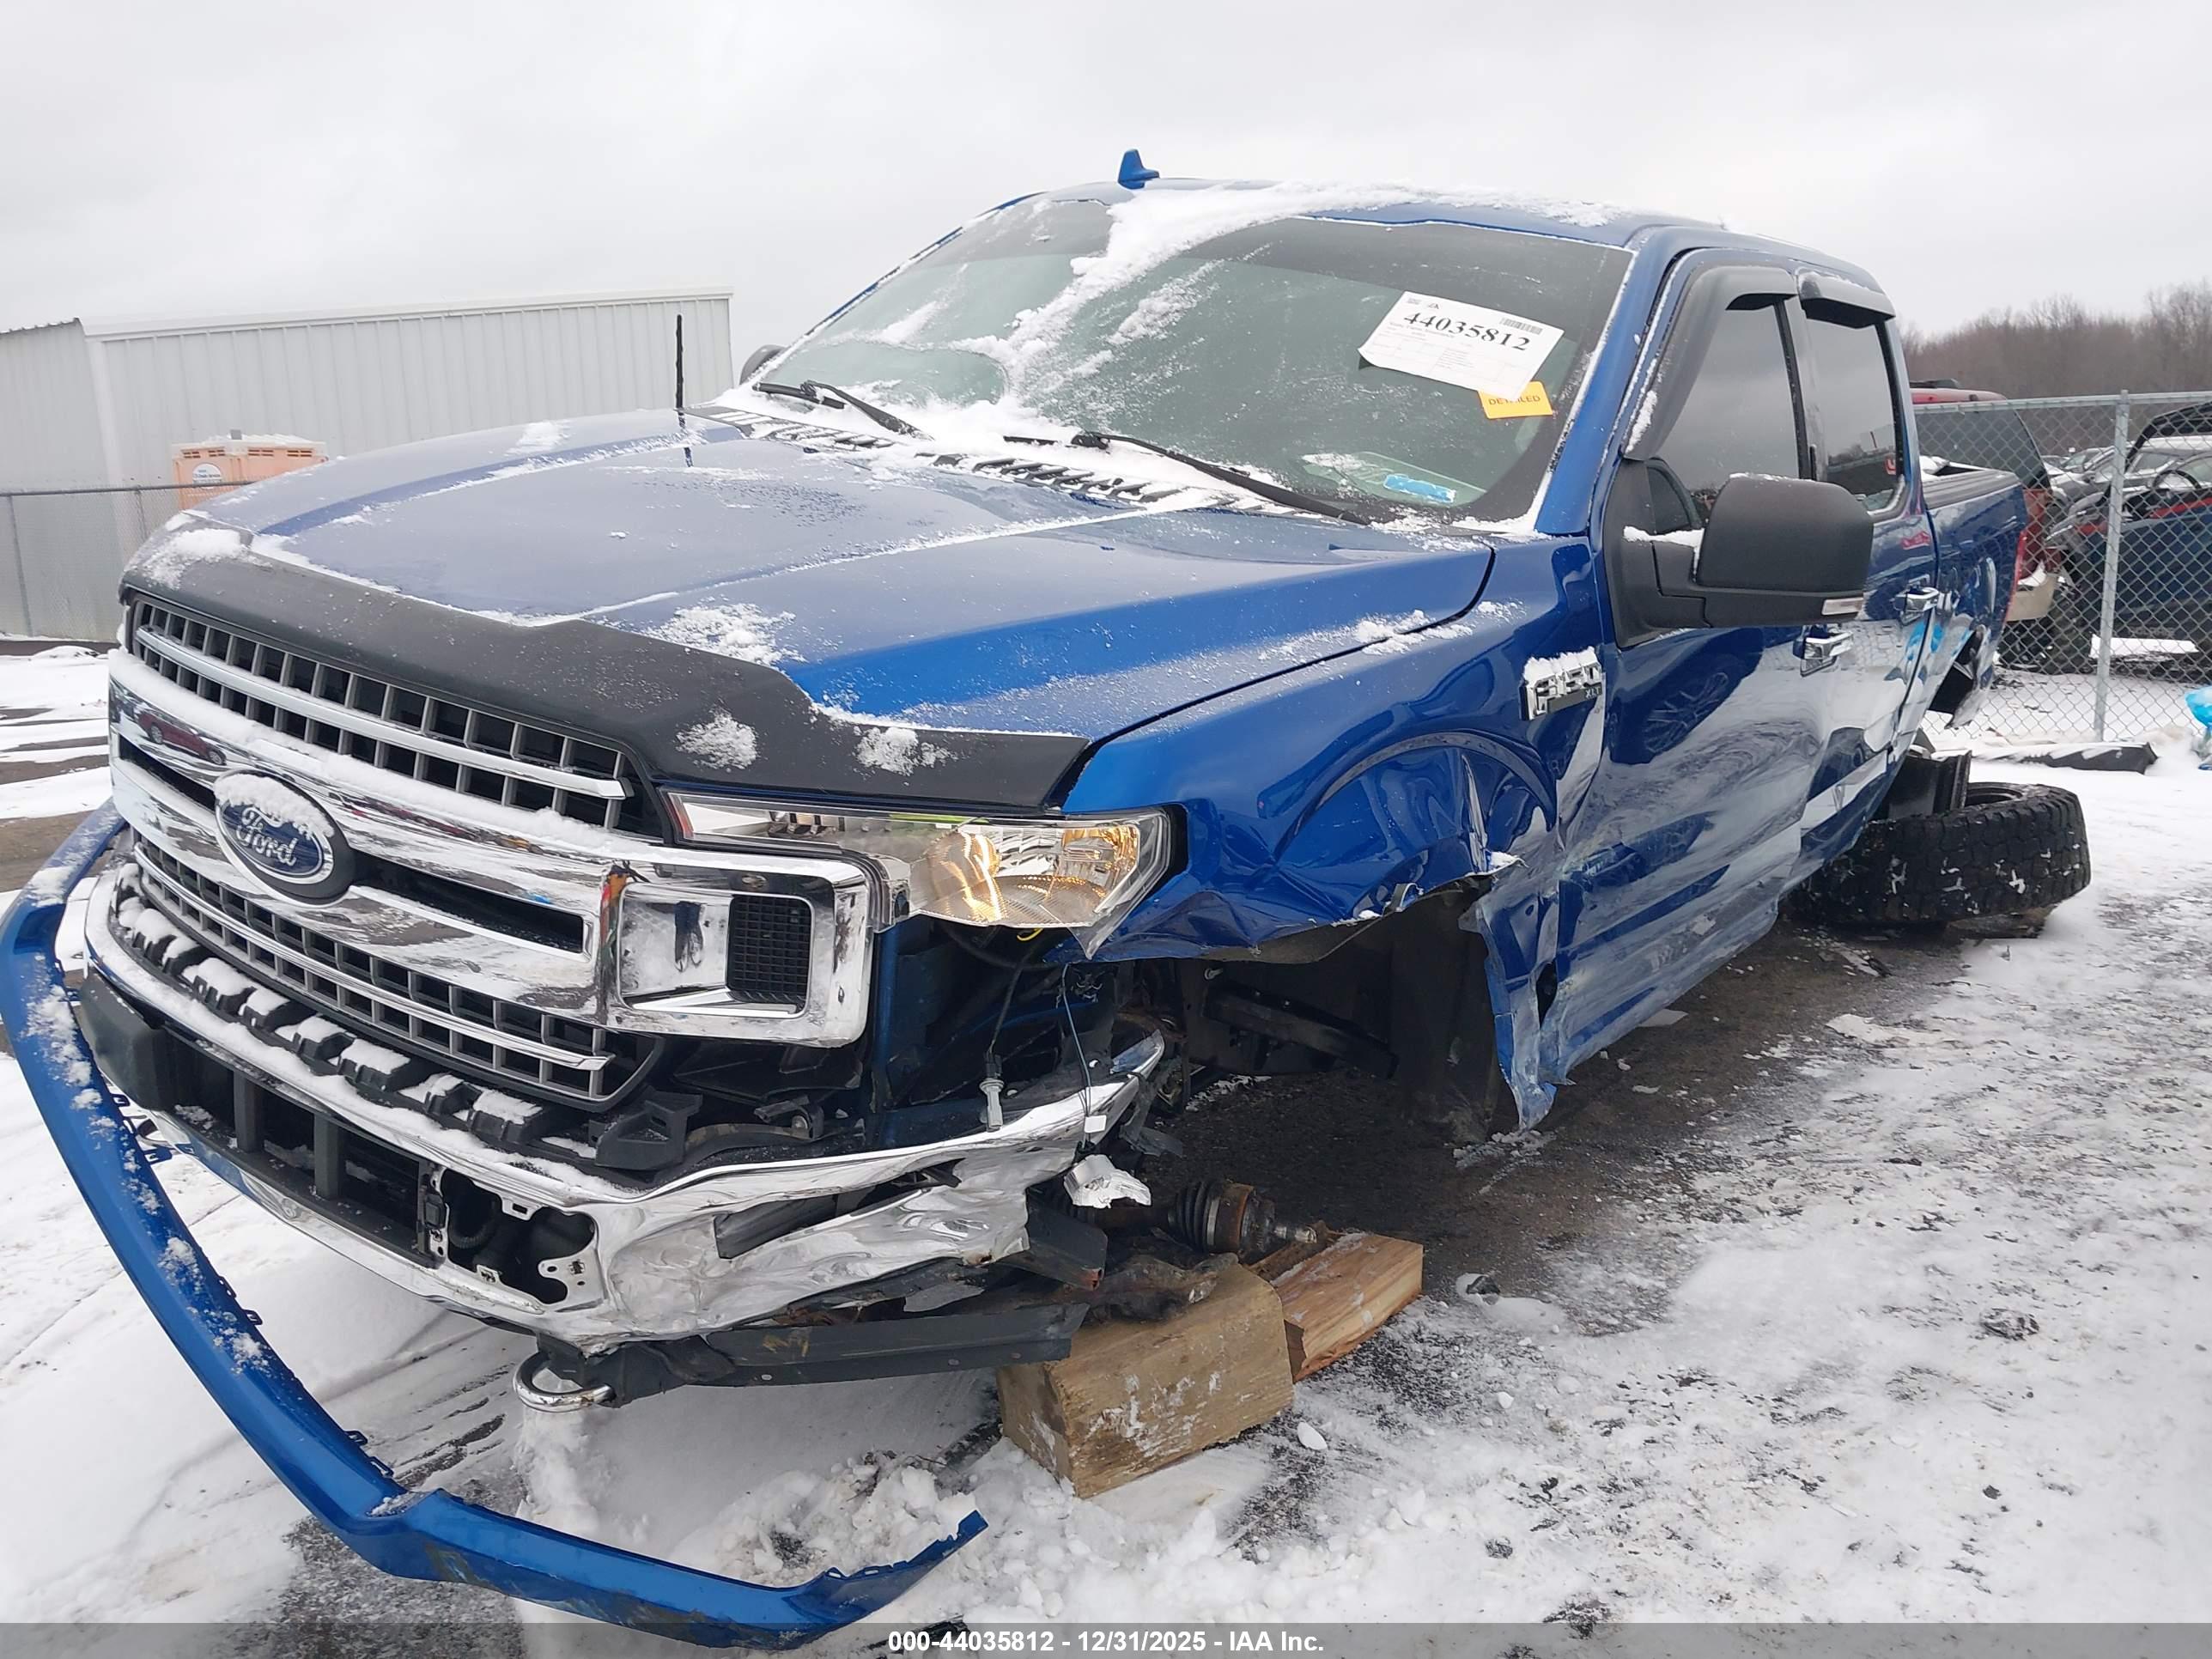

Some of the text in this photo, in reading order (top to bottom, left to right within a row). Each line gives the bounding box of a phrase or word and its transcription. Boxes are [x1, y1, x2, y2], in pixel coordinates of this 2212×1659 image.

[1403, 312, 1531, 351] 44035812
[1488, 395, 1541, 405] DETILED
[1584, 685, 1601, 701] XLT
[235, 806, 299, 867] Ford
